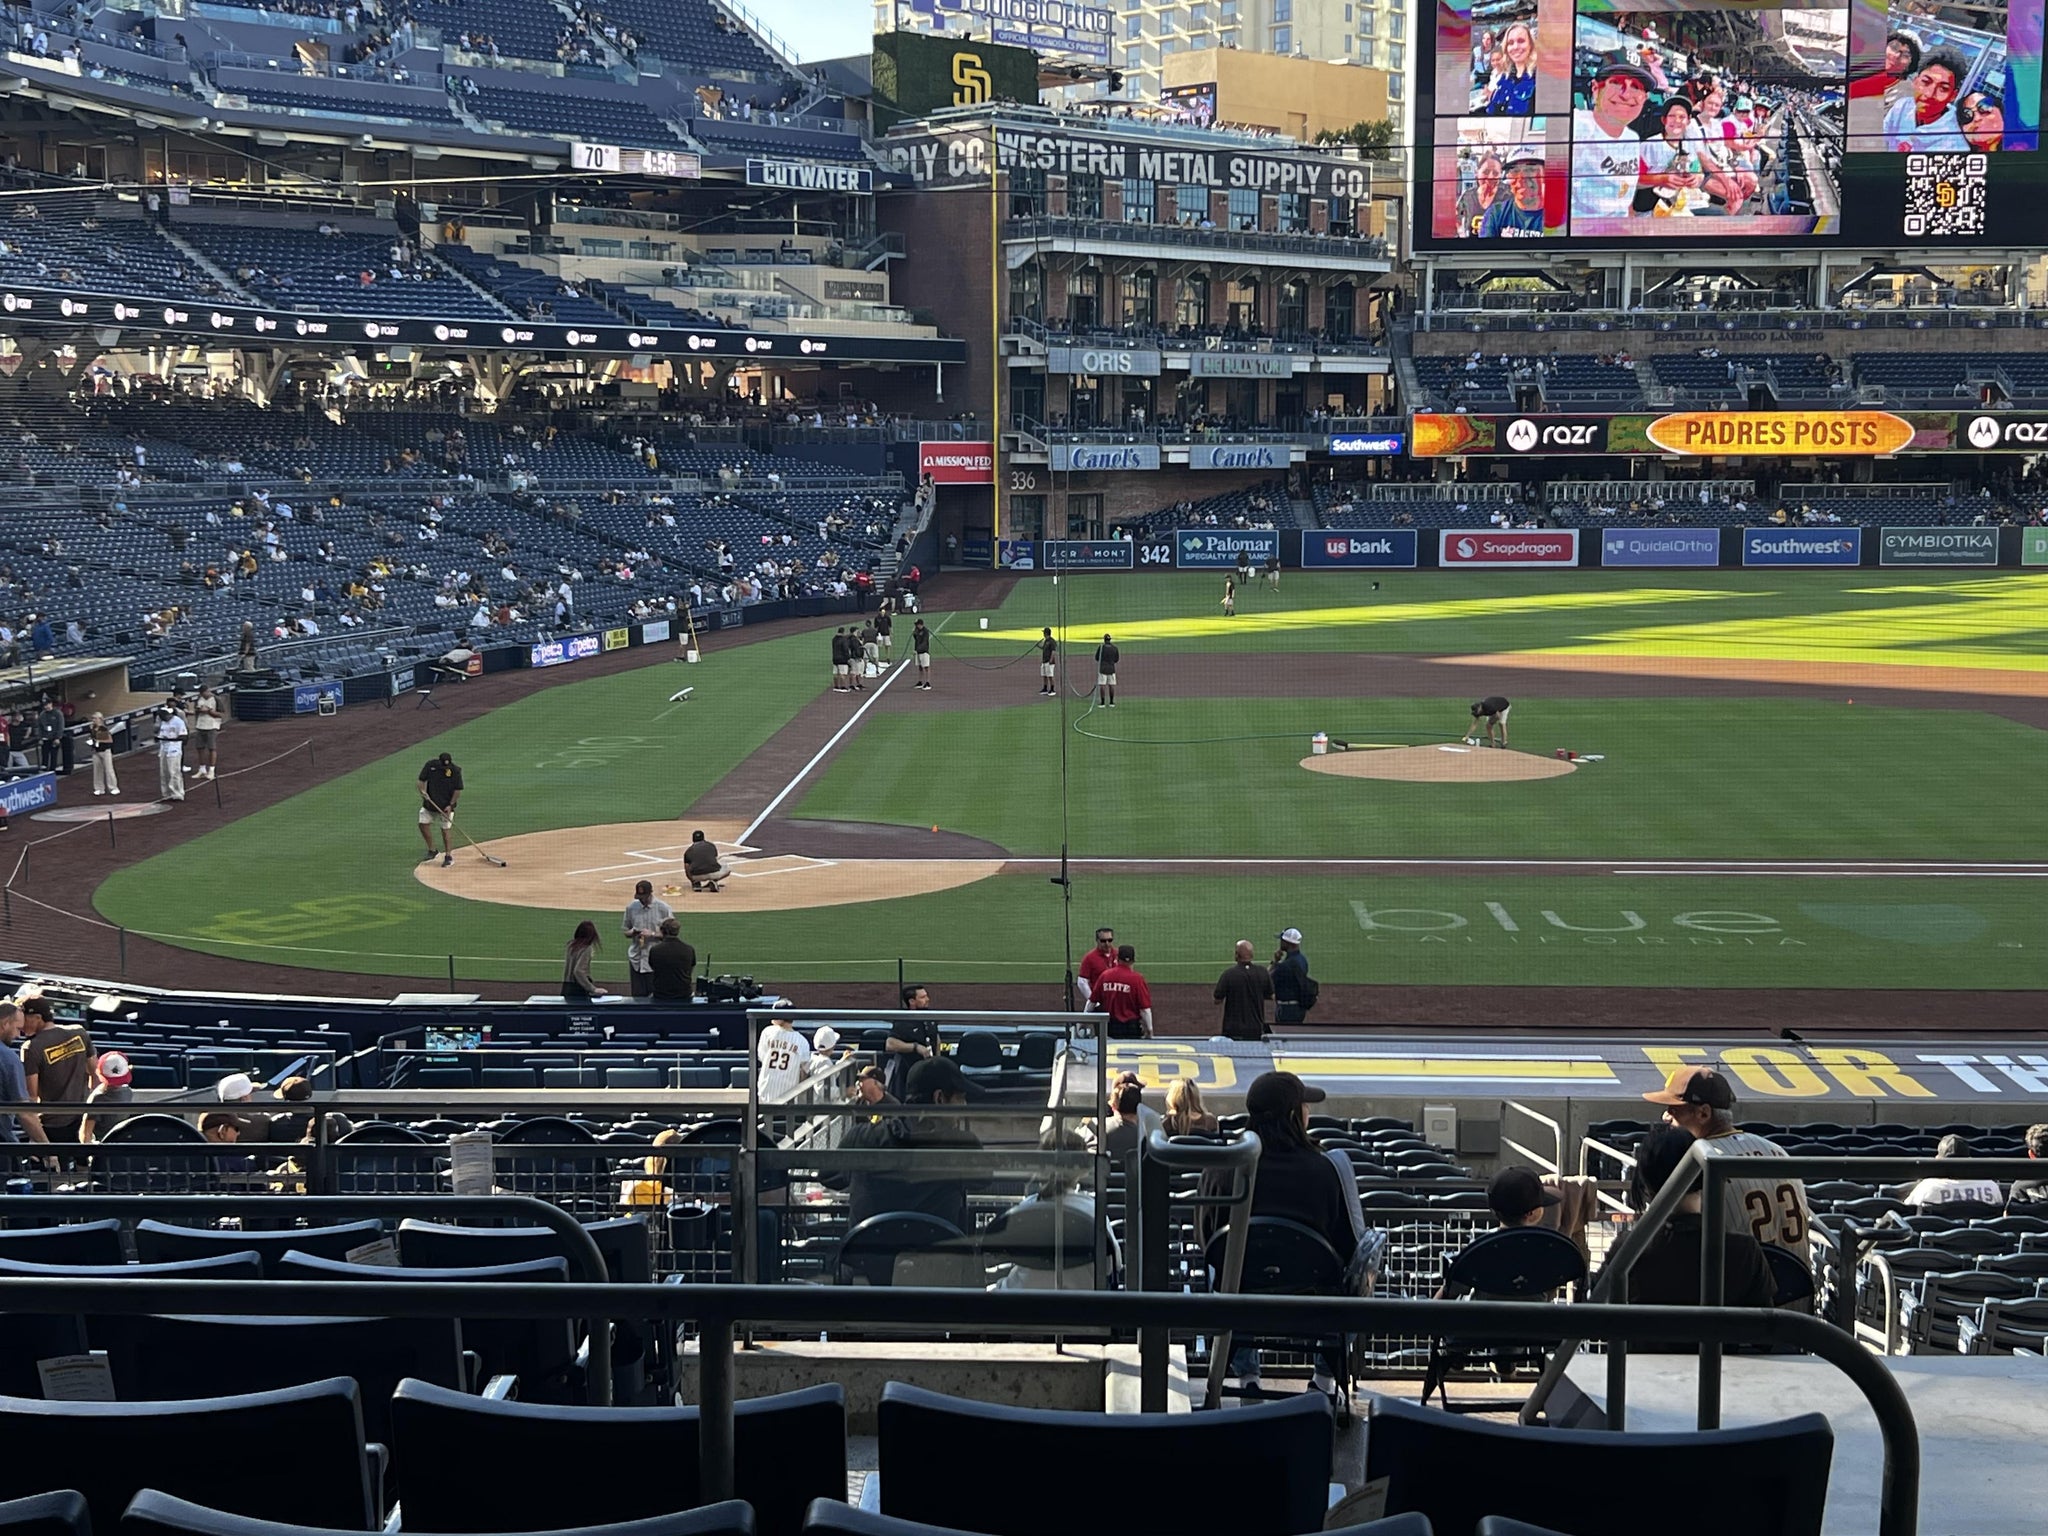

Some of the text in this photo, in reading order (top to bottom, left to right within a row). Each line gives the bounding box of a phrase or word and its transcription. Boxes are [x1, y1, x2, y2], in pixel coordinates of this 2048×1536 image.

[998, 32, 1029, 44] OFFICIAL
[1030, 35, 1075, 49] DIAGNOSTICS
[642, 151, 677, 176] 4:56
[948, 137, 991, 178] CO.
[996, 131, 1369, 200] WESTERN METAL SUPPLY CO.
[762, 163, 860, 190] CUTWATER
[1082, 351, 1132, 373] ORIS
[1543, 425, 1598, 444] razr
[1686, 421, 1878, 446] PADRES POSTS
[1332, 438, 1391, 451] Southwest
[935, 456, 992, 467] MISSION FED
[1072, 447, 1141, 469] Canel's
[1210, 447, 1274, 468] Canel's
[1010, 471, 1036, 490] 336
[1206, 536, 1273, 551] Palomar
[1327, 539, 1392, 554] us bank
[1483, 541, 1561, 556] Snapdragon
[1629, 540, 1713, 554] QuidelOrtho
[1751, 538, 1840, 554] Southwest
[1141, 545, 1170, 563] 342
[1349, 900, 1783, 932] blue
[1103, 982, 1131, 993] ELITE
[769, 1050, 790, 1071] 23
[1640, 1046, 1938, 1097] FOR
[1940, 1186, 1994, 1203] PARIS
[1744, 1182, 1804, 1244] 23
